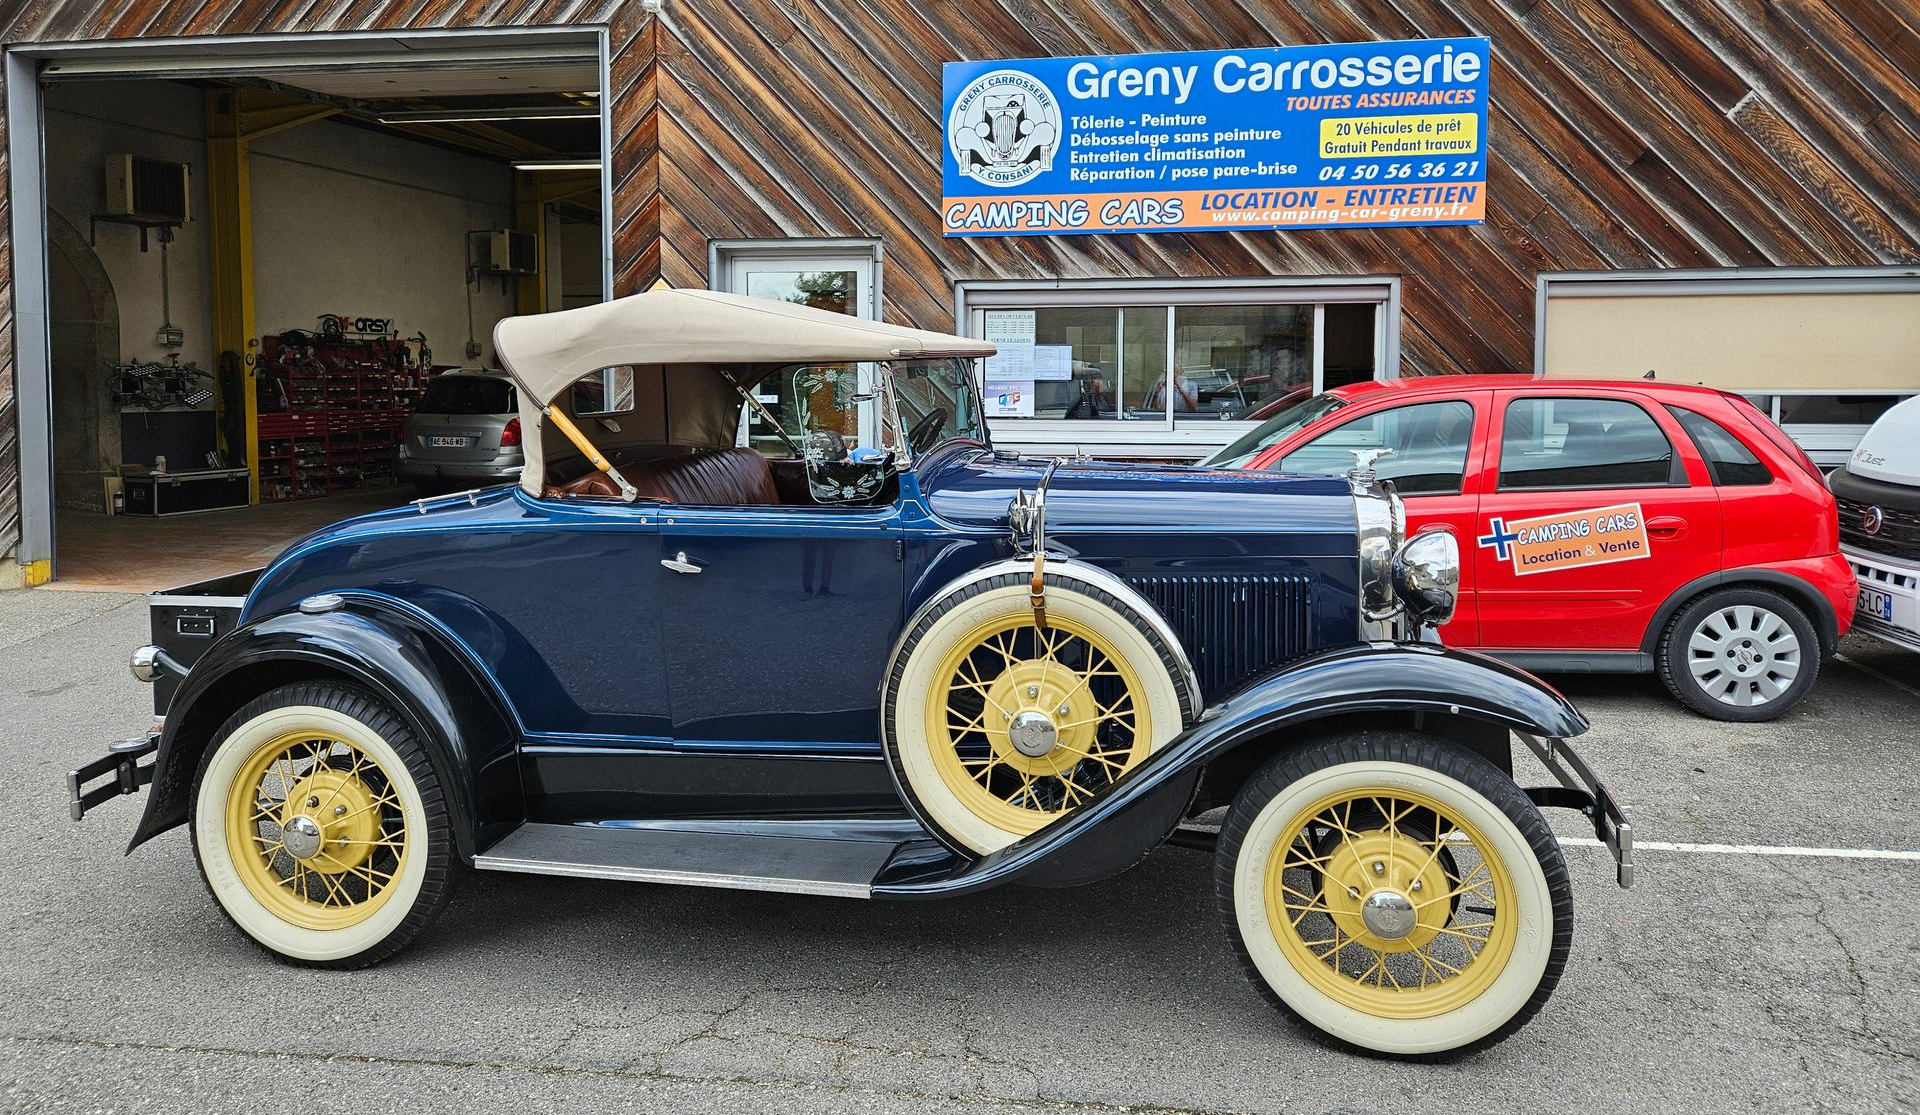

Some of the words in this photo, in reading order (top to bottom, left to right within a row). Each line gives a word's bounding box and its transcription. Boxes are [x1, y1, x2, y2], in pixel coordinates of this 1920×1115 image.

[1067, 62, 1199, 105] Greny
[1213, 45, 1481, 93] Carrosserie
[959, 82, 986, 112] GRENY
[988, 76, 1051, 110] CARROSSERIE
[1286, 95, 1352, 111] TOUTES
[1356, 89, 1476, 108] ASSURANCES
[1071, 115, 1125, 129] Tôlerie
[1141, 113, 1207, 127] Peinture
[1336, 123, 1351, 136] 20
[1355, 121, 1413, 135] Véhicules
[1417, 119, 1432, 133] de
[1436, 118, 1461, 135] prêt
[1070, 131, 1169, 147] Débosselage
[1173, 132, 1209, 143] sans
[1214, 129, 1282, 145] peinture
[1325, 141, 1367, 154] Gratuit
[1372, 139, 1421, 152] Pendant
[1425, 138, 1472, 151] travaux
[1070, 149, 1139, 164] Entretien
[1144, 146, 1245, 161] climatisation
[978, 167, 985, 177] Y.
[987, 165, 1034, 181] CONSANI
[1070, 166, 1155, 183] Réparation
[1159, 165, 1168, 180] /
[1171, 167, 1208, 181] pose
[1213, 161, 1298, 180] pare-brise
[1319, 166, 1347, 181] 04
[1351, 165, 1380, 180] 50
[1384, 163, 1413, 179] 56
[1418, 162, 1446, 178] 36
[1451, 161, 1480, 177] 21
[1201, 191, 1319, 210] LOCATION
[1344, 186, 1478, 206] ENTRETIEN
[945, 200, 1090, 228] CAMPING
[1100, 198, 1184, 225] CARS
[1212, 202, 1468, 223] www.camping-car-greny.fr
[1861, 453, 1886, 466] Just
[1517, 519, 1591, 545] CAMPING
[1596, 512, 1638, 533] CARS
[1522, 548, 1581, 565] Location
[1584, 544, 1597, 557] &
[1599, 540, 1640, 554] Vente
[1857, 590, 1883, 615] 5-LC
